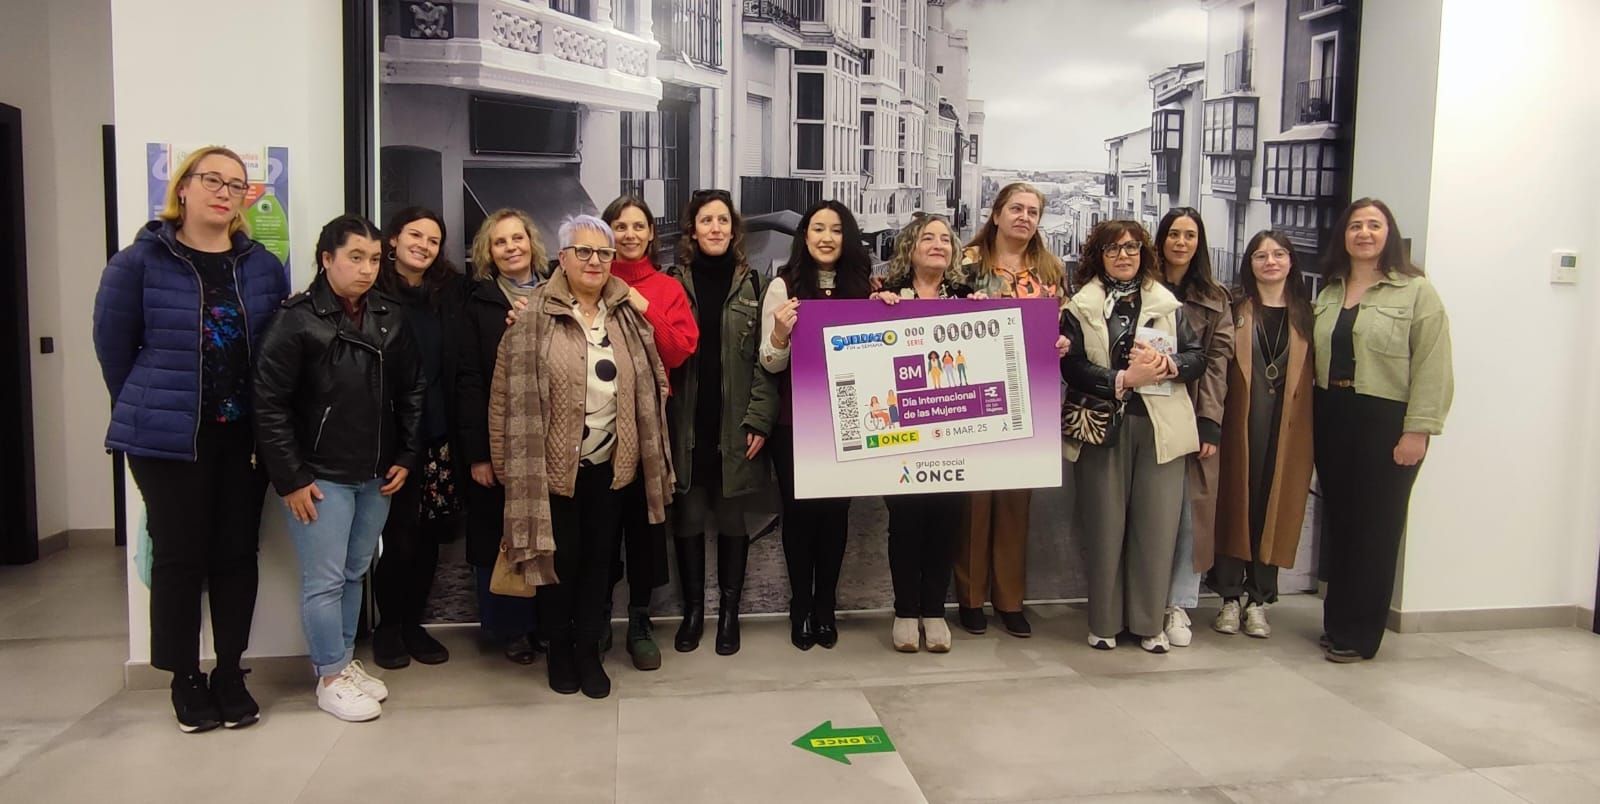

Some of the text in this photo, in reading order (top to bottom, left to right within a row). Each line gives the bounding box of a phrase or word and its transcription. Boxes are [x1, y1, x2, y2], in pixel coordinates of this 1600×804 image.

[904, 326, 925, 337] 000
[933, 318, 1000, 343] 00000
[906, 339, 924, 347] SERIE
[899, 365, 922, 380] 8M
[902, 390, 976, 407] Día Internacional
[903, 405, 967, 419] de las Mujeres
[945, 429, 951, 437] 8
[953, 425, 974, 434] MAR.
[977, 423, 988, 432] 25
[881, 432, 917, 445] ONCE
[916, 458, 965, 468] grupo social
[916, 469, 965, 483] ONCE
[816, 738, 861, 746] ONCE
